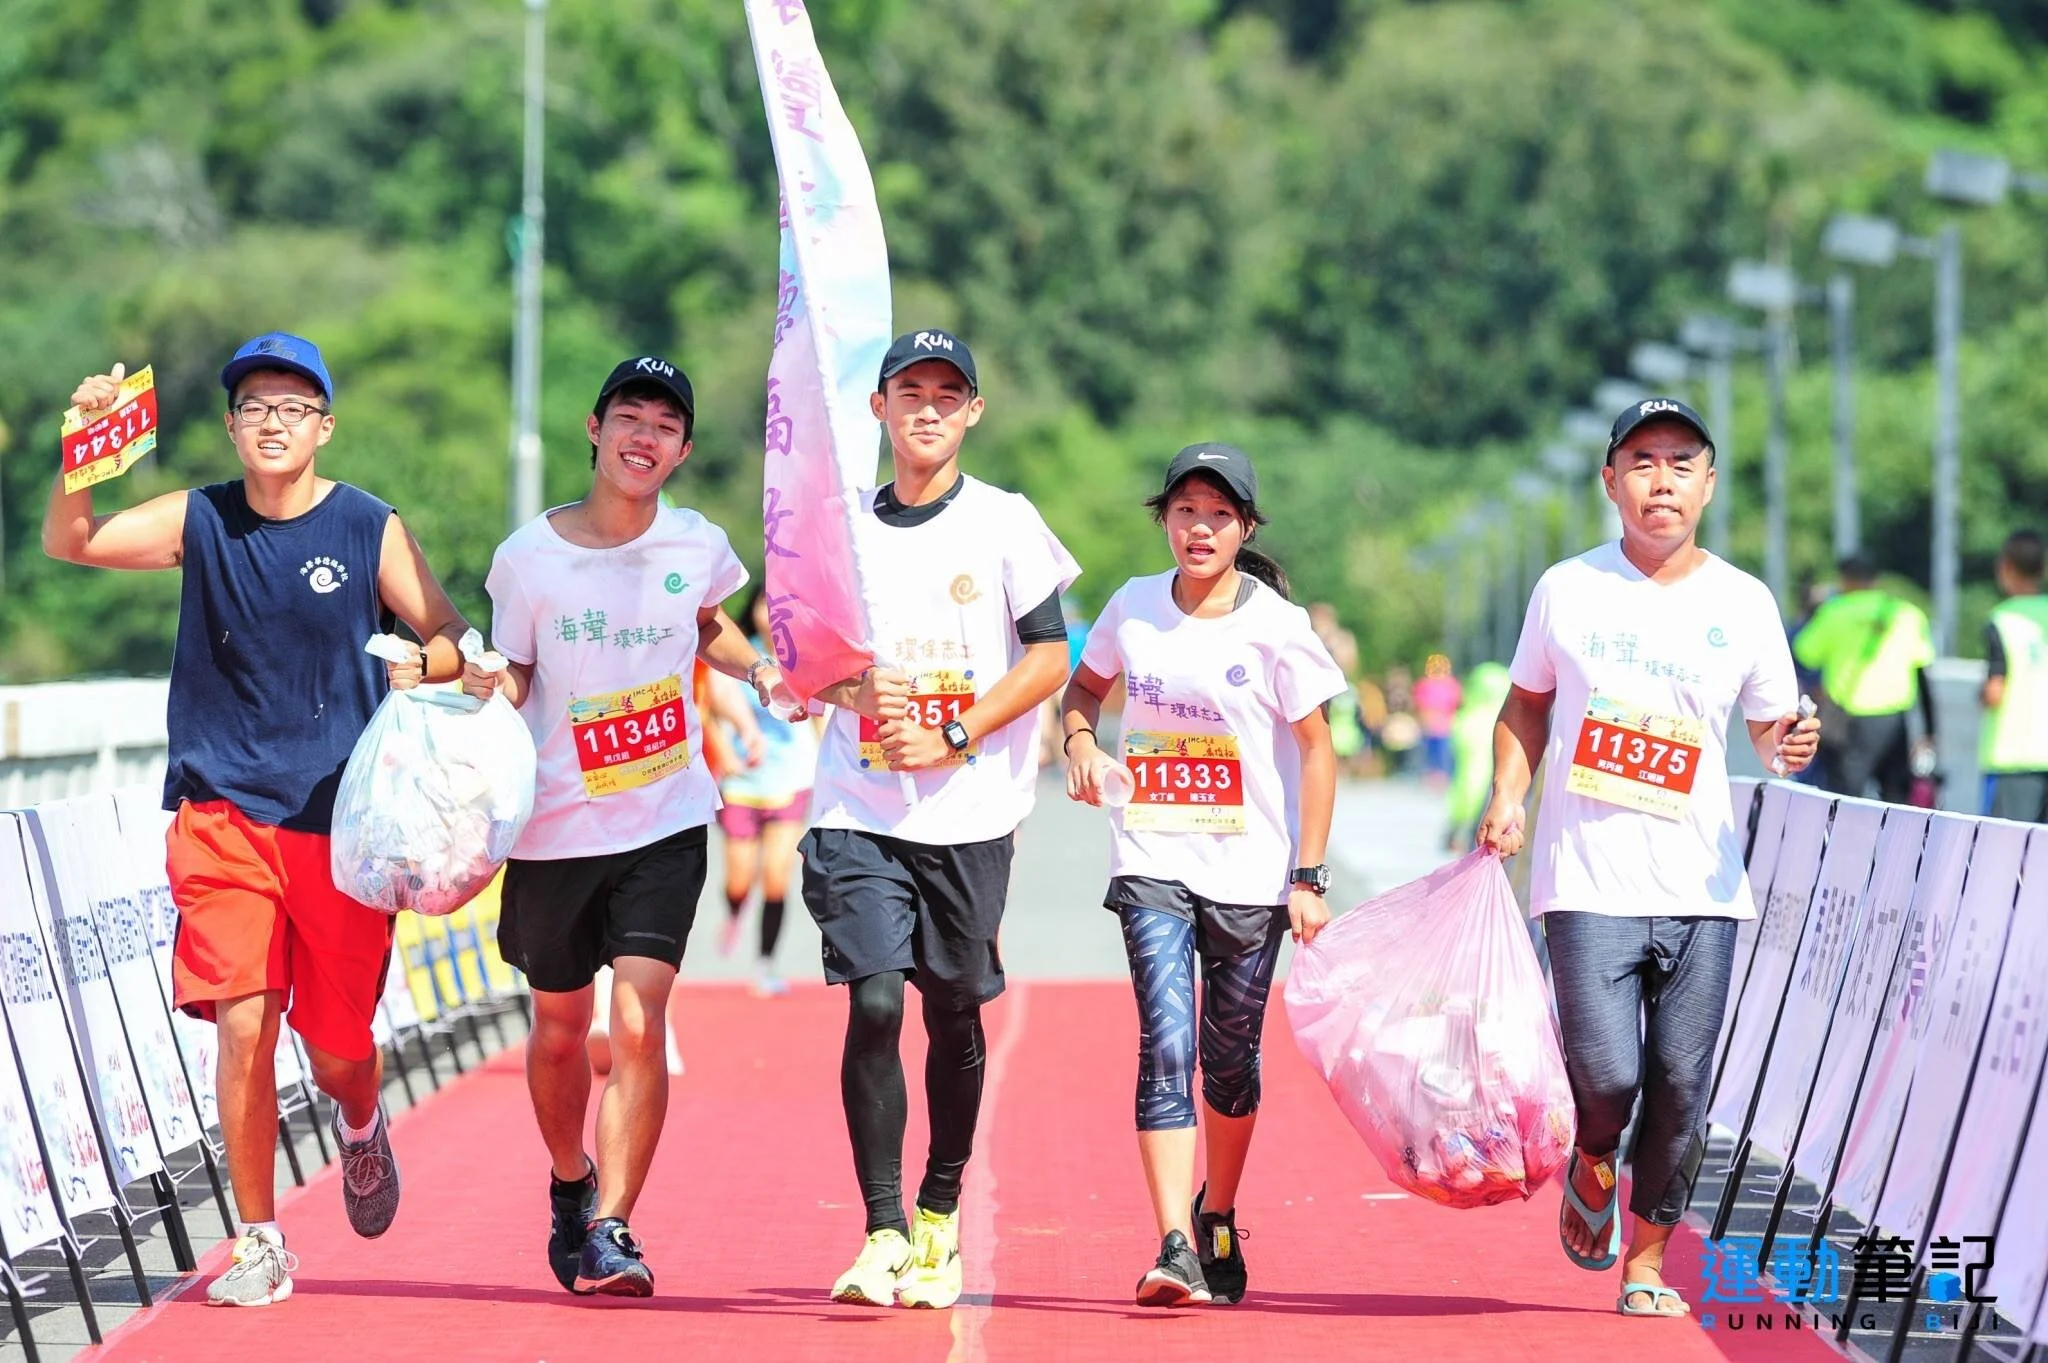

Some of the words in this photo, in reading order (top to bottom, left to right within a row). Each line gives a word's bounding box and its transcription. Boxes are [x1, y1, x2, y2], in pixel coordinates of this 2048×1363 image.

[914, 332, 953, 351] RUN
[635, 357, 674, 377] RUN
[1640, 400, 1679, 416] RUN
[73, 408, 151, 464] 11344
[554, 608, 611, 653] 海聲
[613, 624, 675, 649] 環保志工
[895, 638, 975, 662] 環保志工
[903, 699, 961, 727] 351
[1170, 702, 1225, 722] 環保志工
[583, 707, 677, 753] 11346
[1588, 727, 1689, 775] 11375
[1135, 762, 1231, 789] 11333
